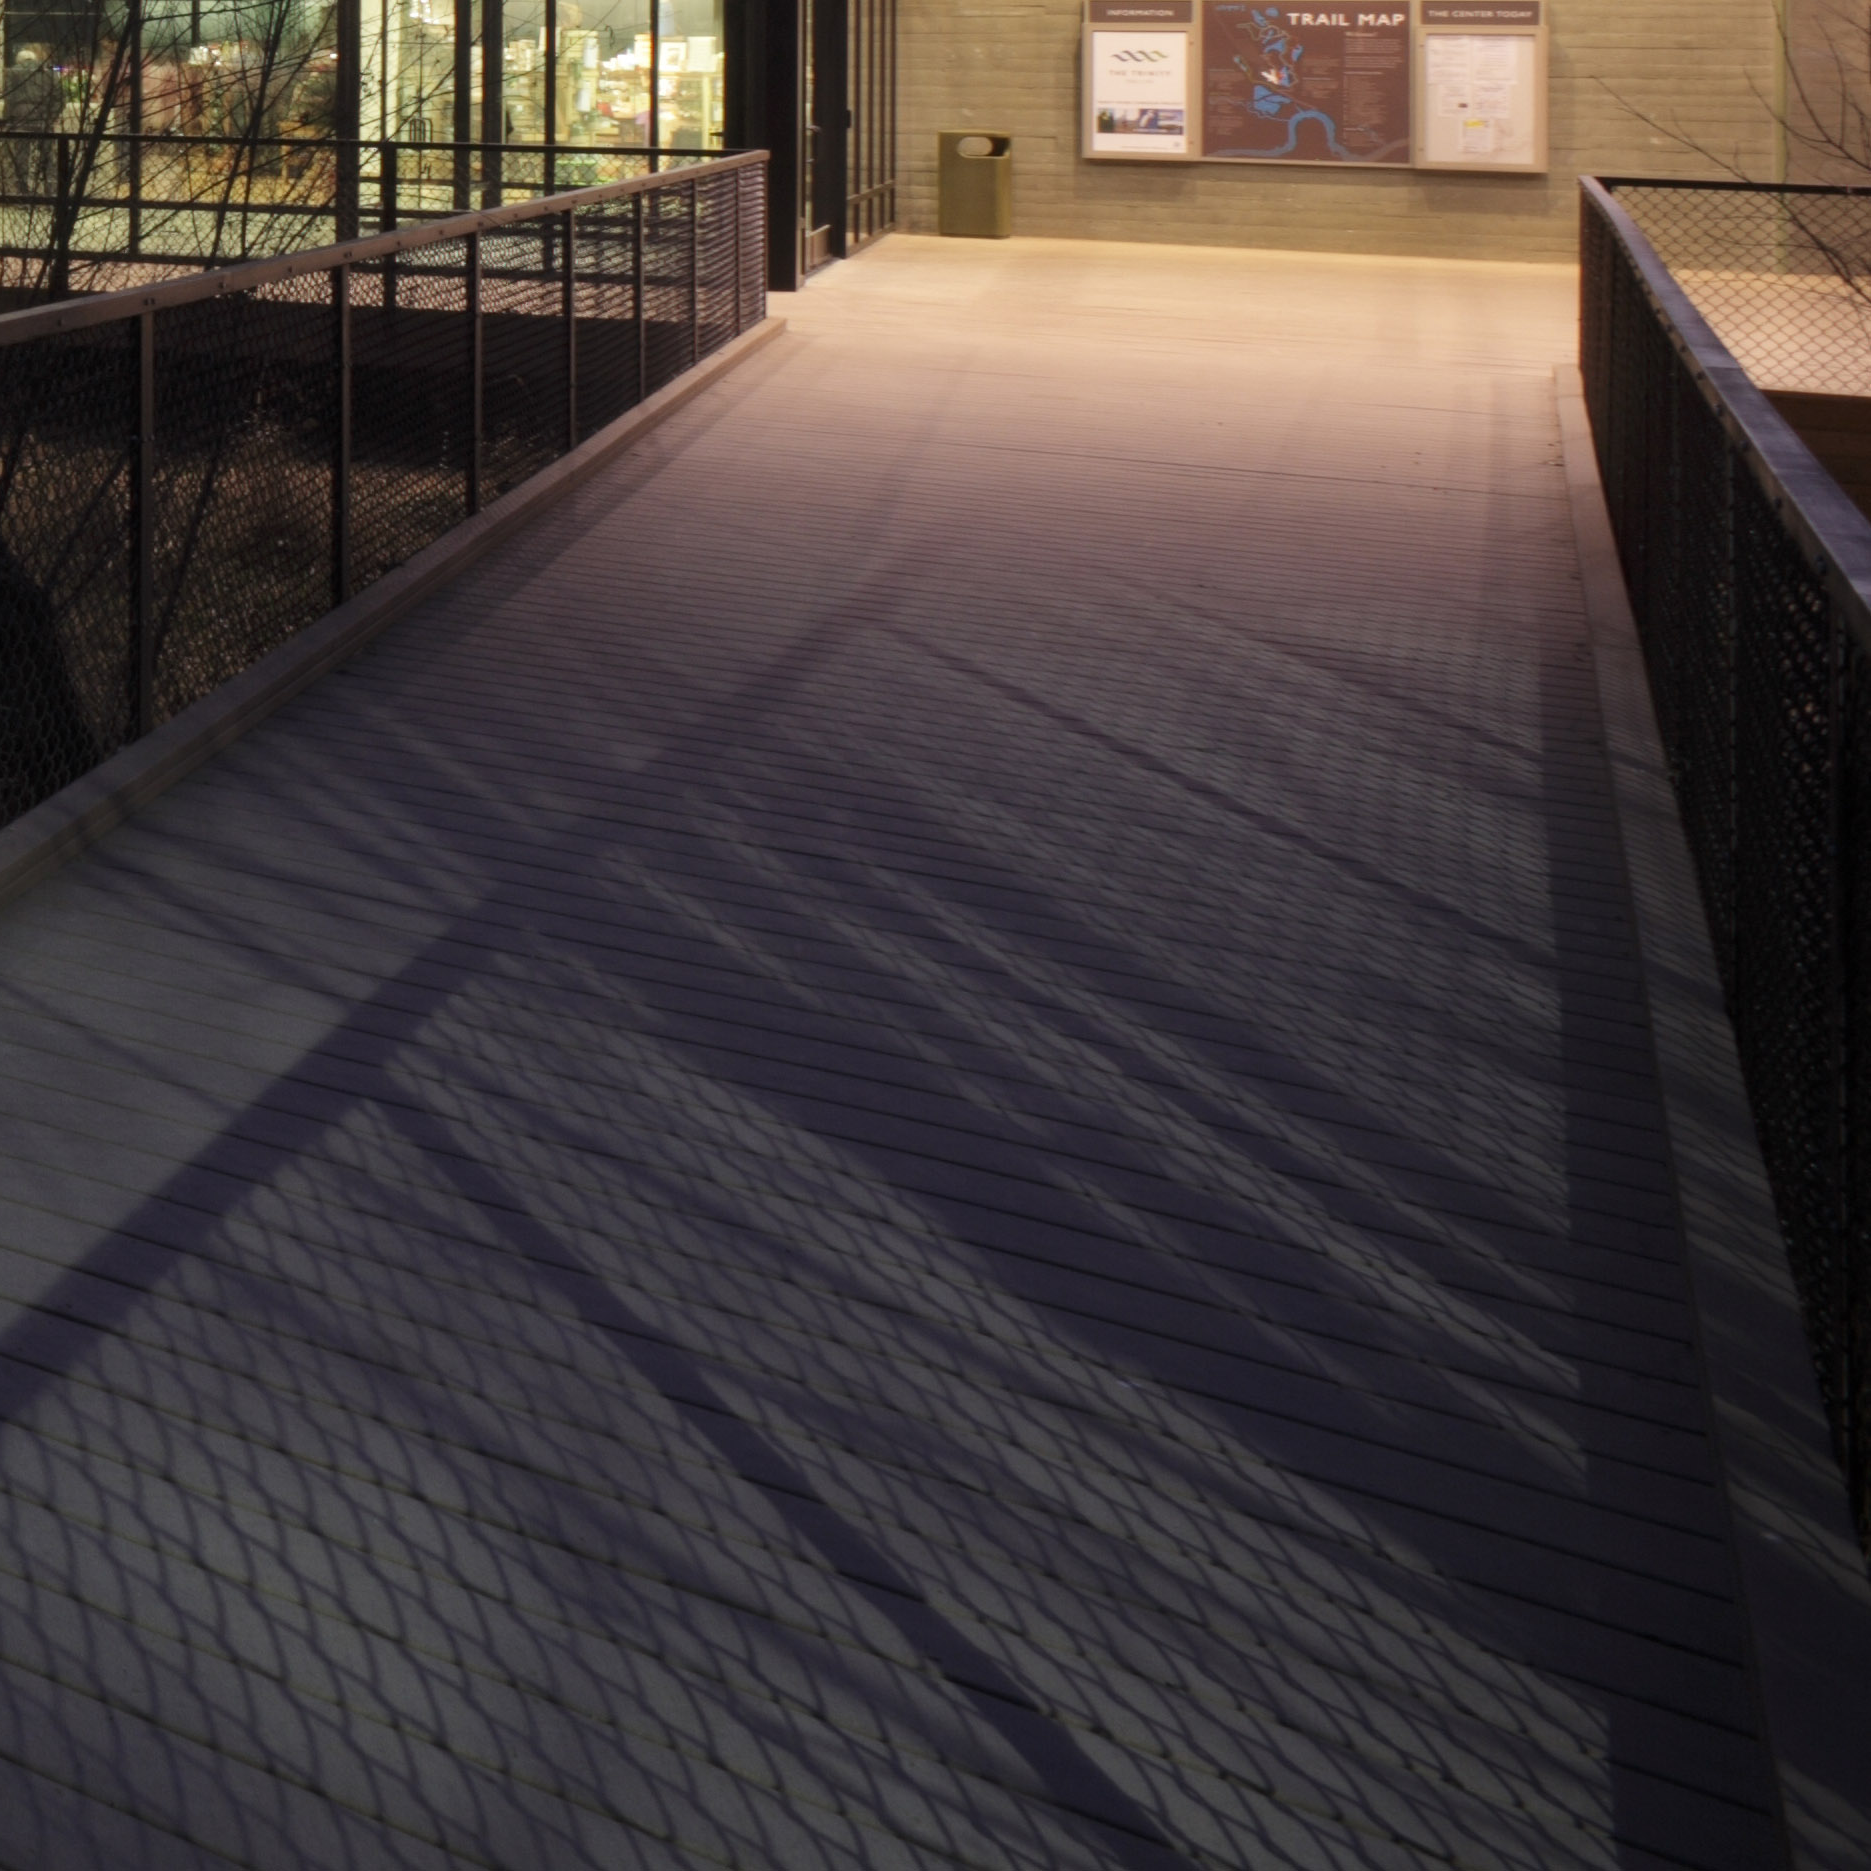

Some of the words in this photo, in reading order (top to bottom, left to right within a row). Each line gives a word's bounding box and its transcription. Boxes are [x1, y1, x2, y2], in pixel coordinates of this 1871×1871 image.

[1106, 9, 1175, 17] INFORMATION
[1427, 9, 1449, 17] THE
[1451, 10, 1494, 18] CENTER
[1496, 10, 1533, 18] TODAY
[1286, 12, 1350, 26] TRAIL
[1357, 13, 1406, 27] MAP
